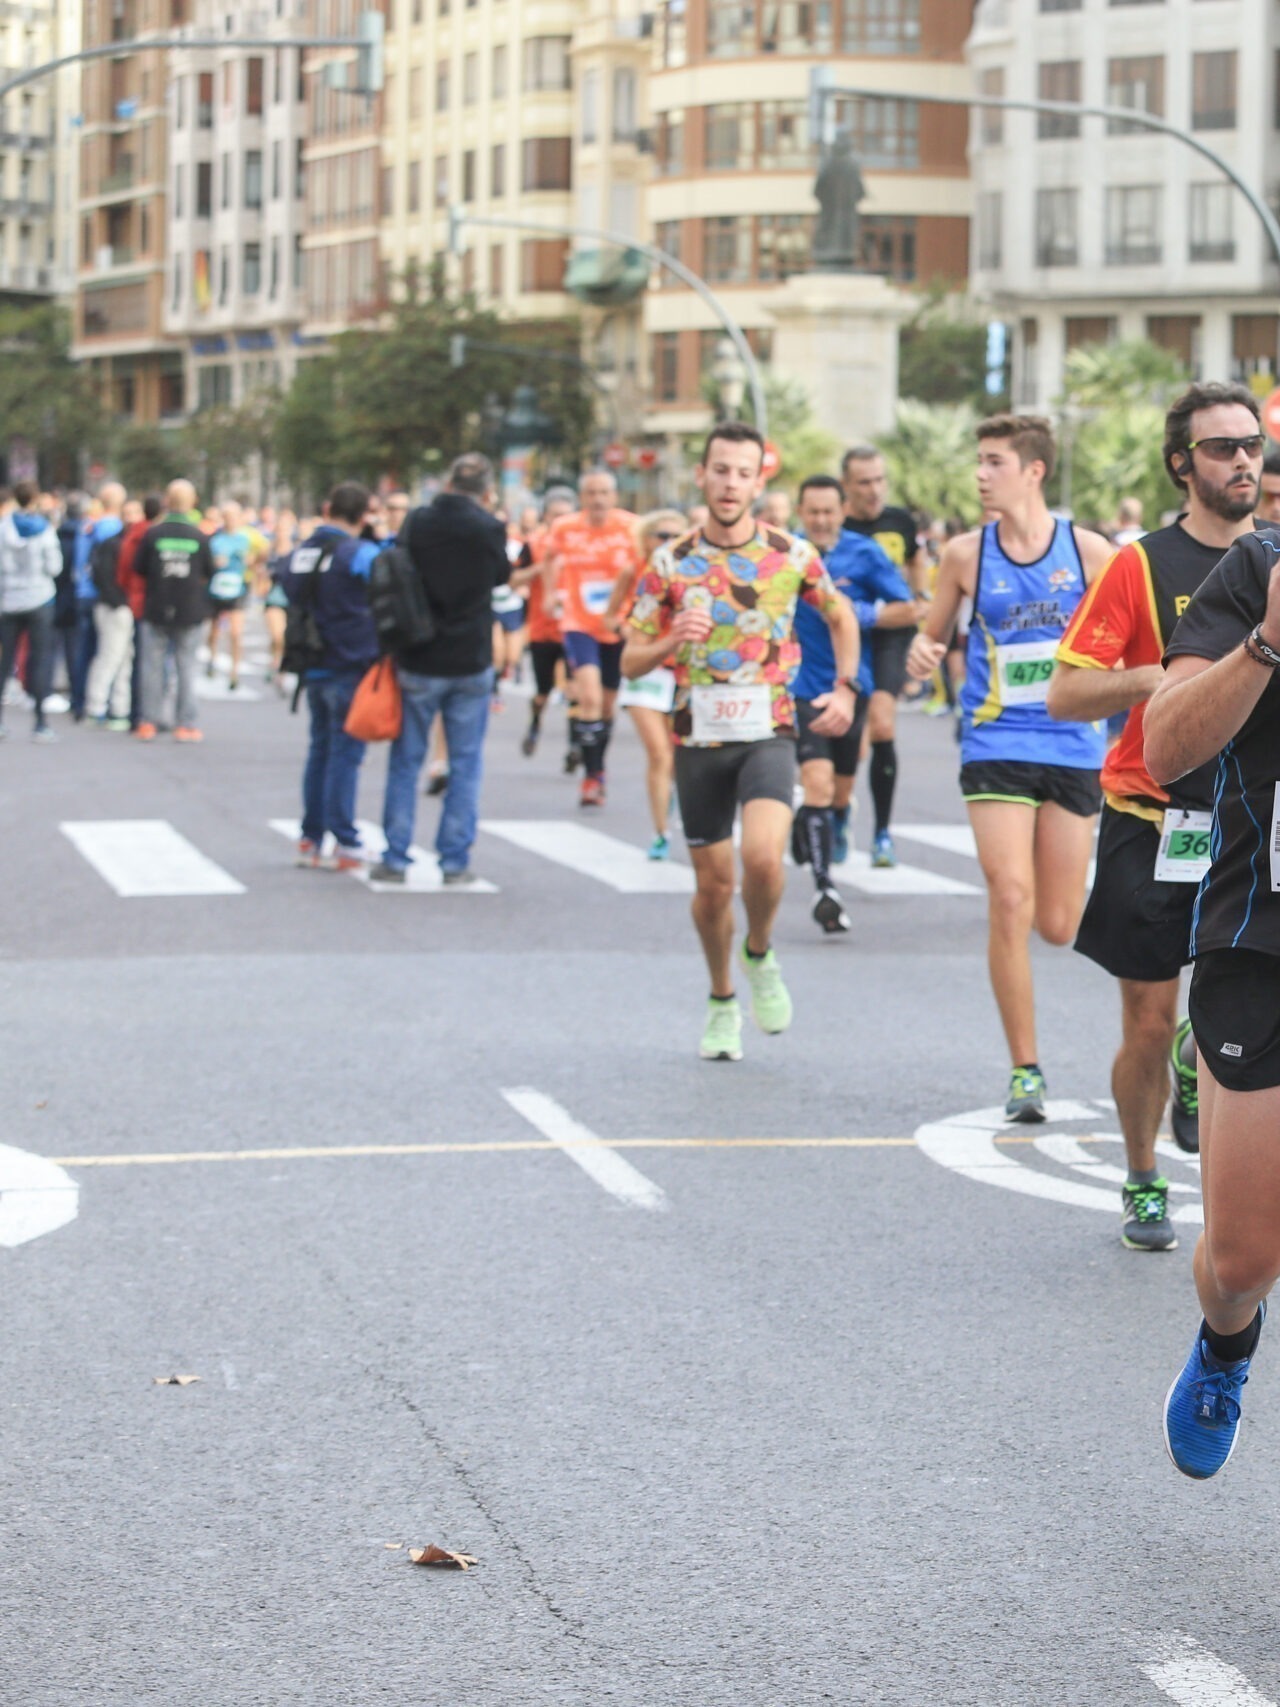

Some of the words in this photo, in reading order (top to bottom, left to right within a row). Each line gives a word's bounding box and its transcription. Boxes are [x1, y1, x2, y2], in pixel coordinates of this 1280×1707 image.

[1013, 661, 1054, 683] 479
[712, 700, 752, 720] 307
[1174, 833, 1211, 856] 36
